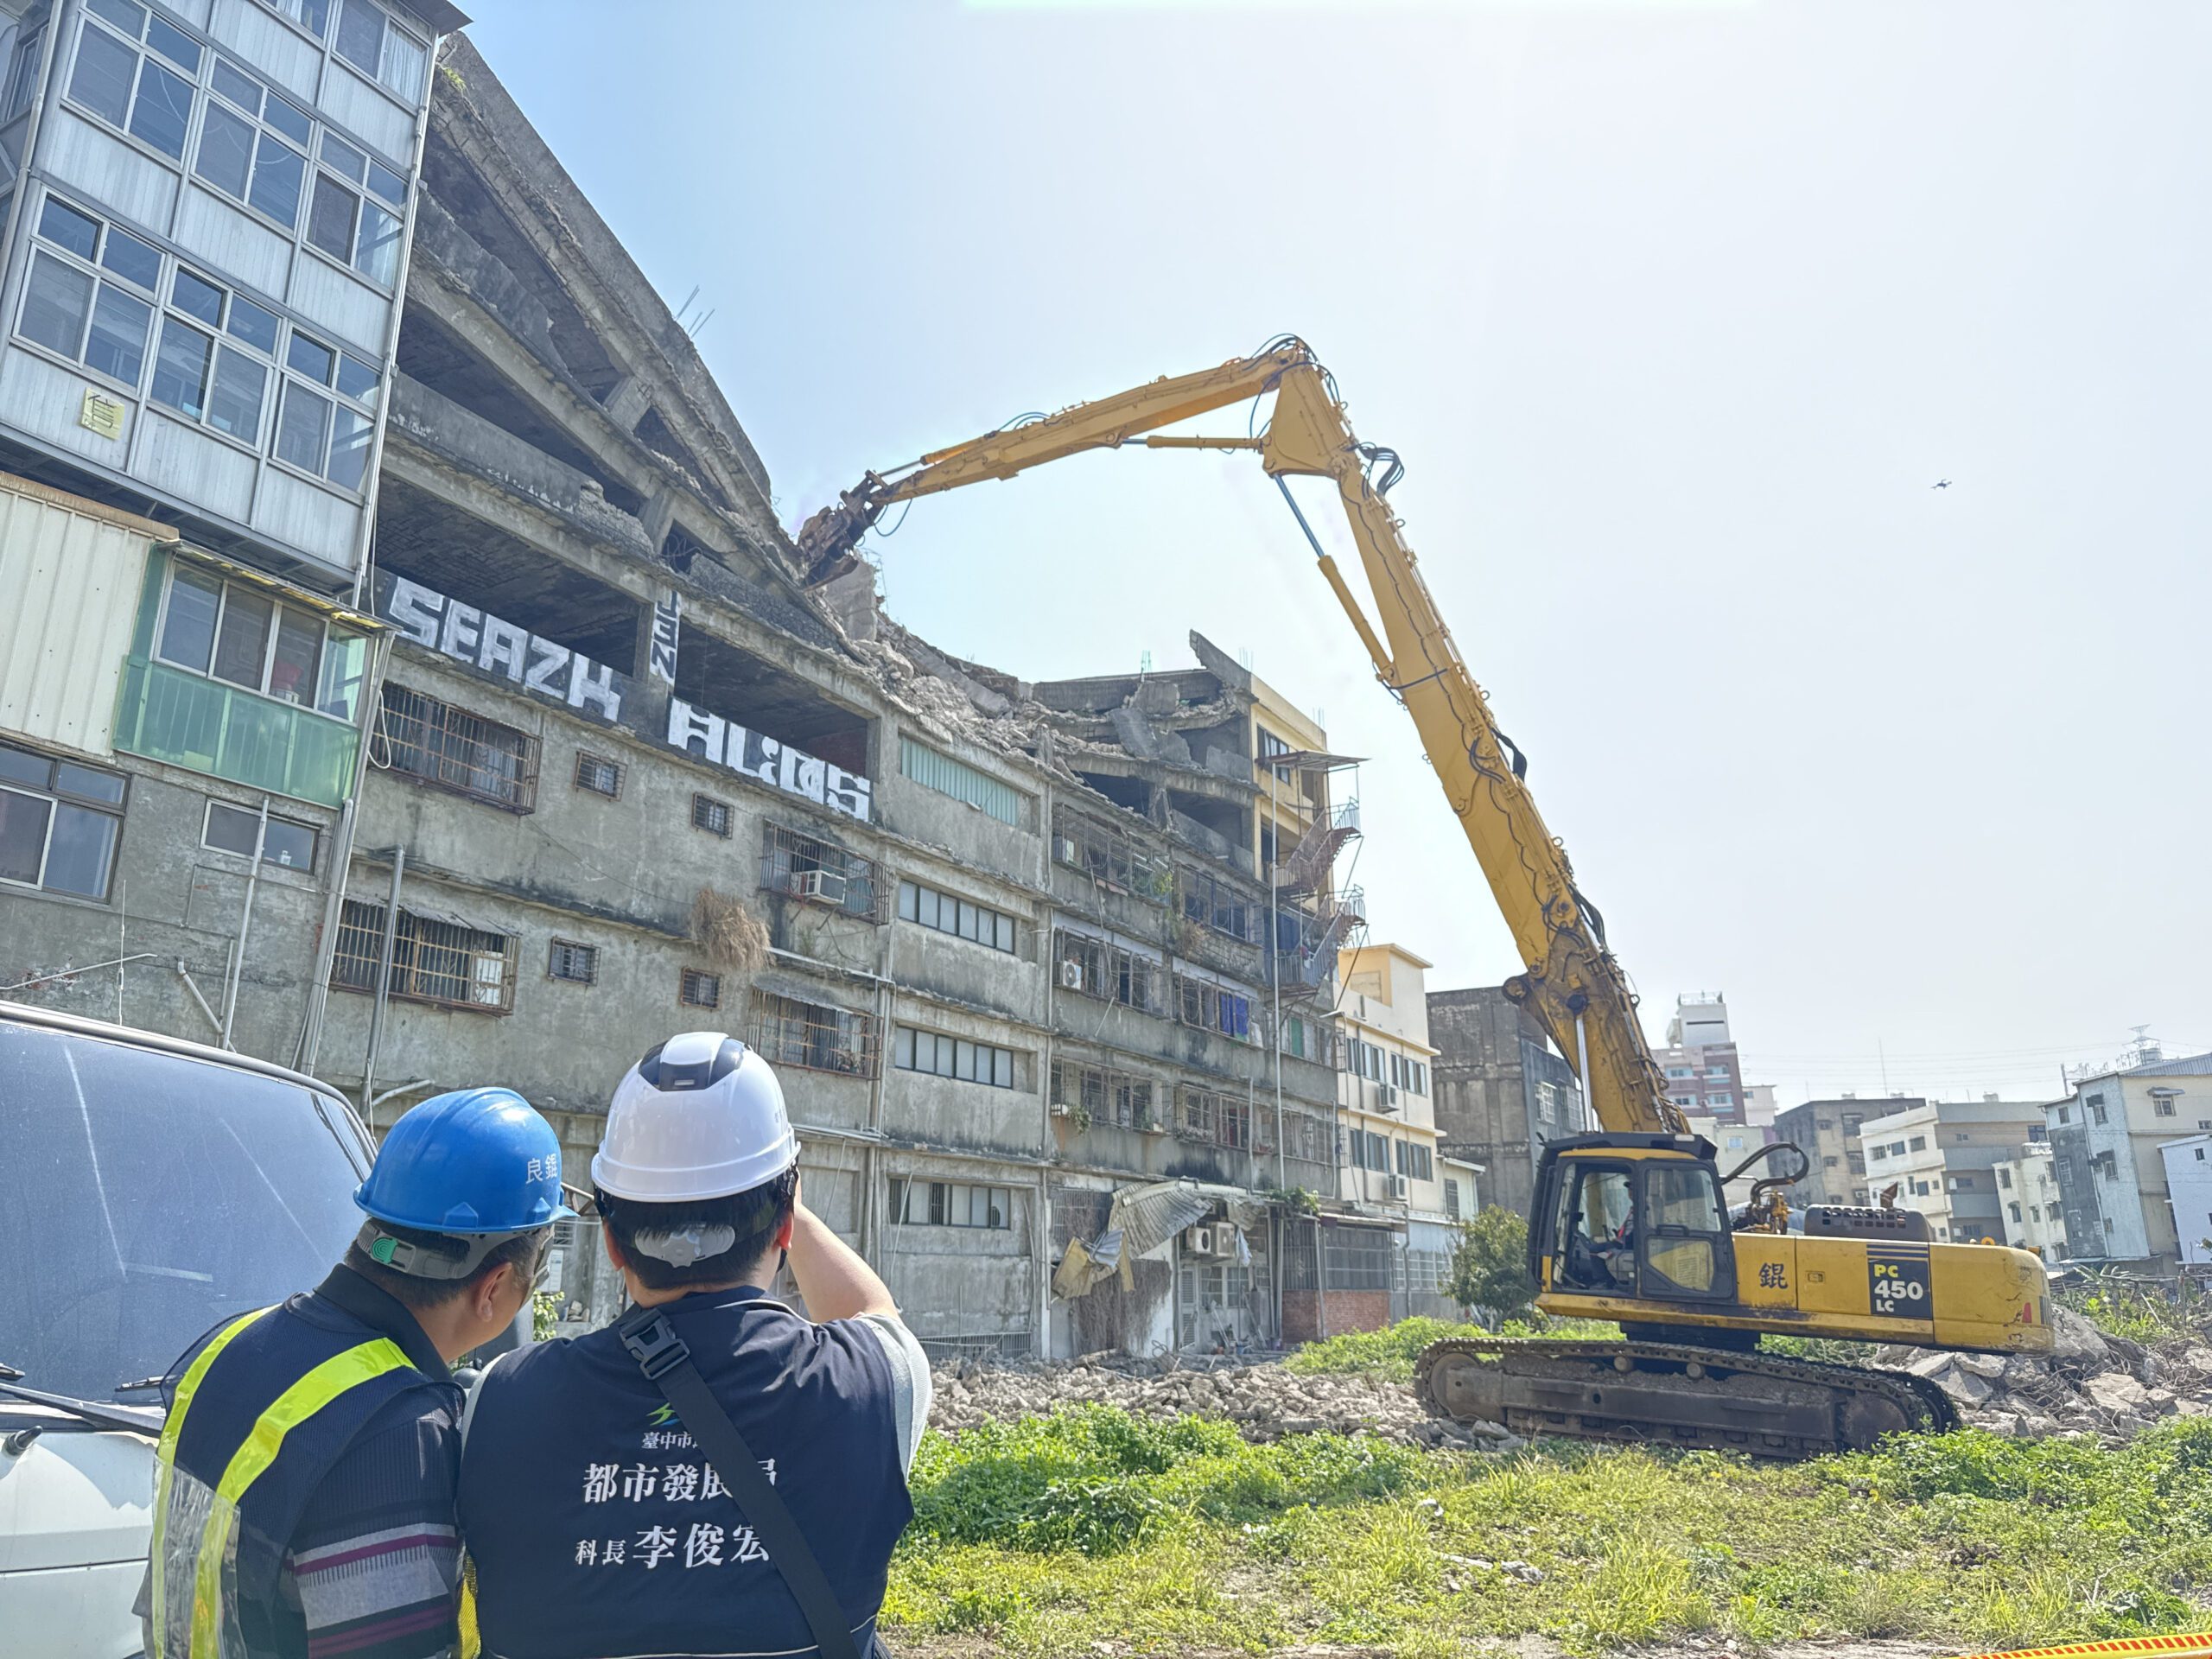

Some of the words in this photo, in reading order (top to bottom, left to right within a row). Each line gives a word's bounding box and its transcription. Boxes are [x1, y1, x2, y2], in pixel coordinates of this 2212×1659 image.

[1873, 1263, 1899, 1278] PC
[1873, 1280, 1923, 1300] 450
[1875, 1299, 1895, 1313] LC
[641, 1431, 699, 1450] 臺中市
[575, 1539, 626, 1567] 科長
[632, 1522, 770, 1569] 李俊宏
